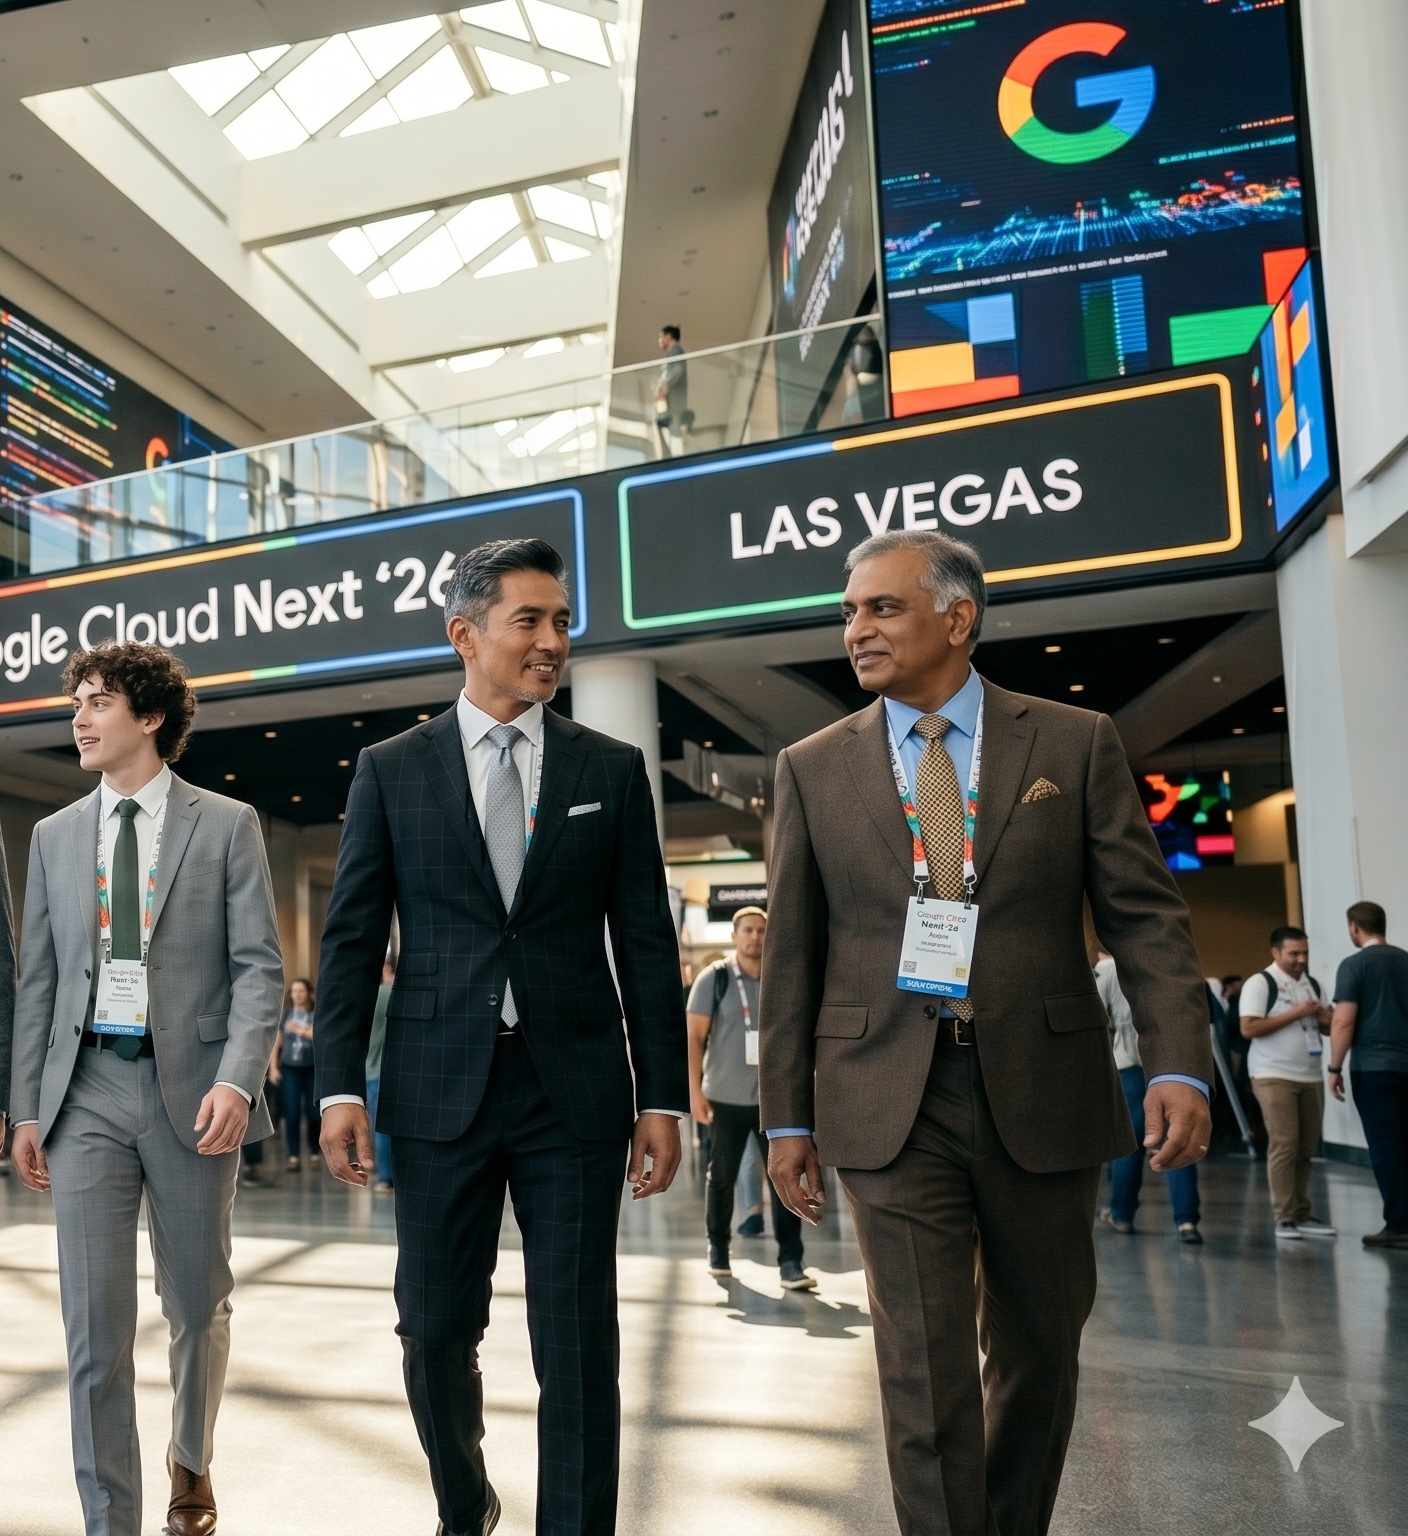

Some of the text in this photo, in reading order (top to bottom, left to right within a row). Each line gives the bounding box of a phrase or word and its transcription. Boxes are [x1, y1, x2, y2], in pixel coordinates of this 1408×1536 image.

[997, 21, 1156, 165] G
[730, 458, 1083, 560] LAS VEGAS
[78, 586, 219, 652] Cloud
[233, 569, 364, 637] Next
